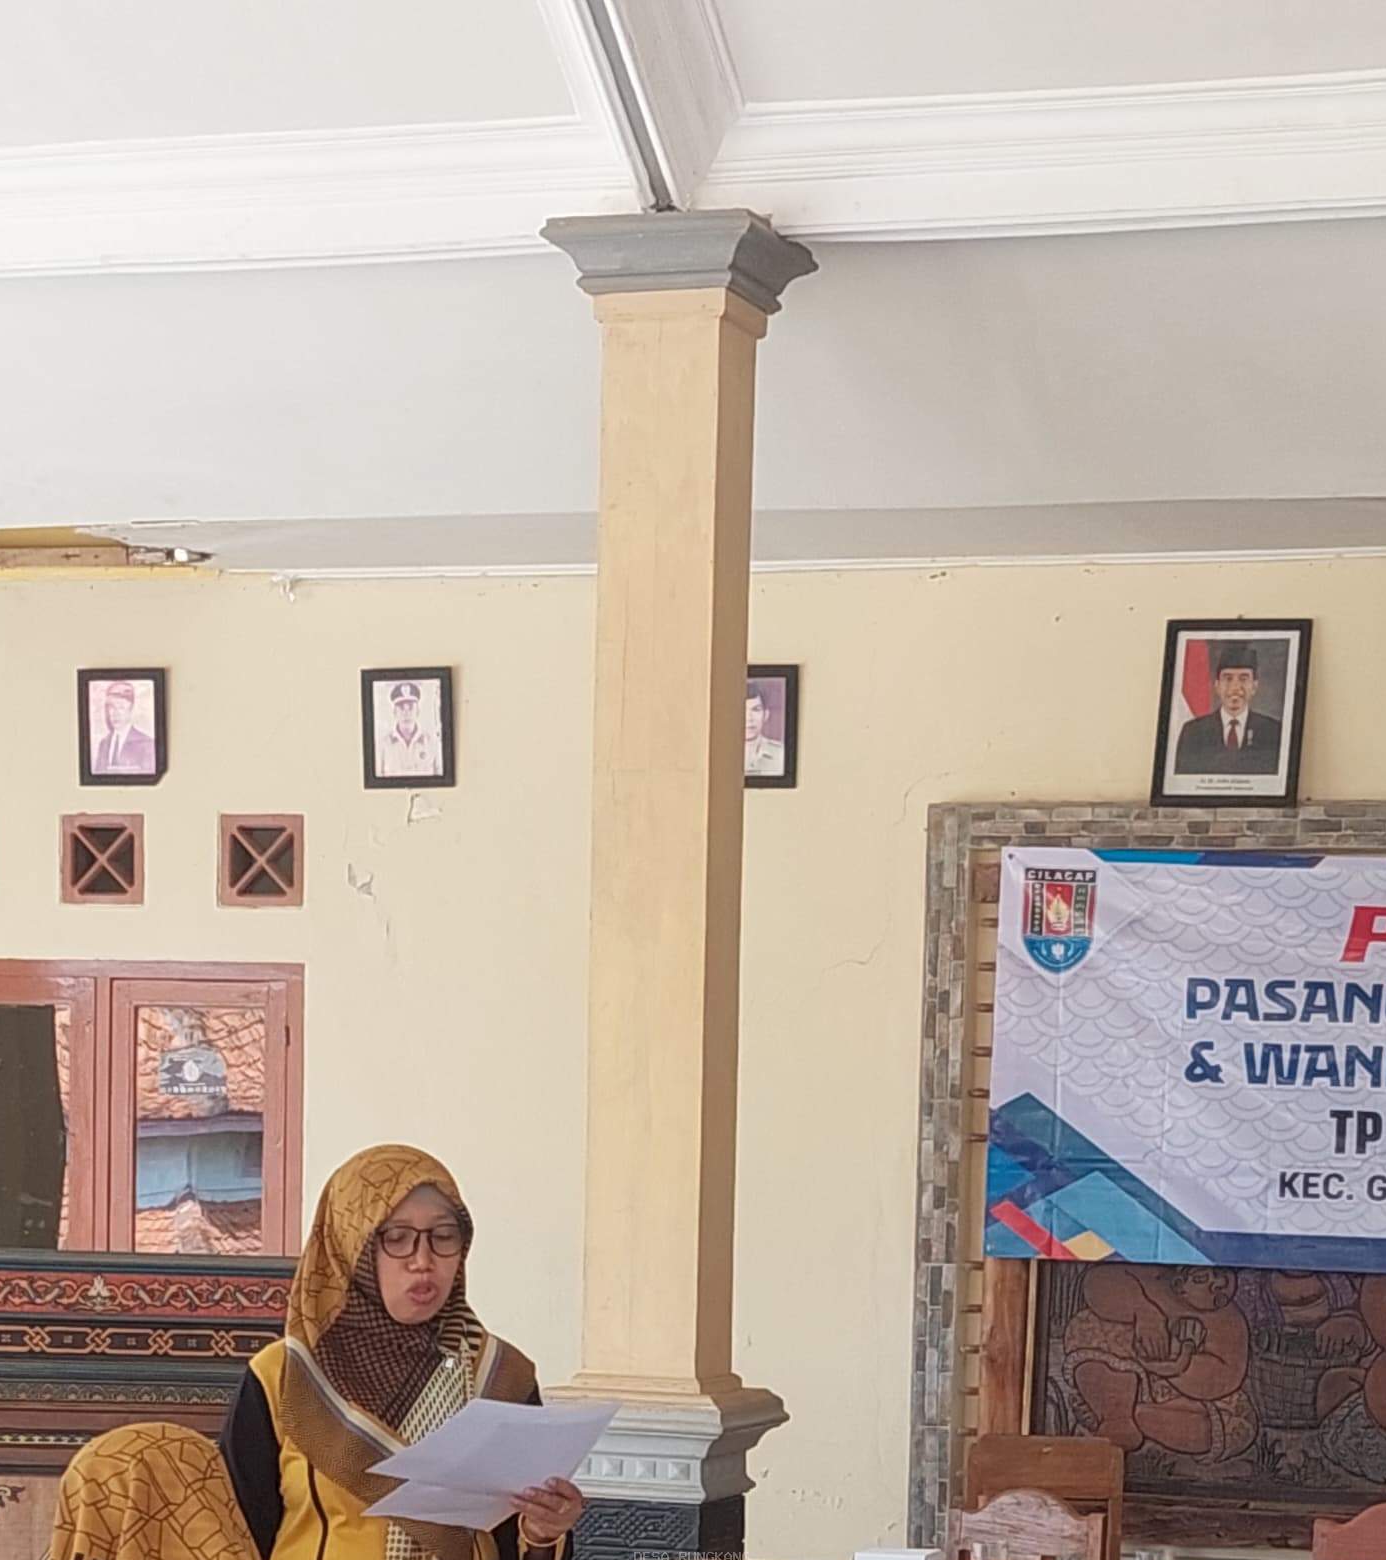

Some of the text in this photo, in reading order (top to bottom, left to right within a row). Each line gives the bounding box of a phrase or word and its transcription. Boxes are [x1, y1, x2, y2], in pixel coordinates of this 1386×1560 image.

[1027, 870, 1094, 881] CILACAP
[1184, 1041, 1225, 1083] &
[1329, 1109, 1383, 1155] TP
[1278, 1171, 1355, 1201] KEC.
